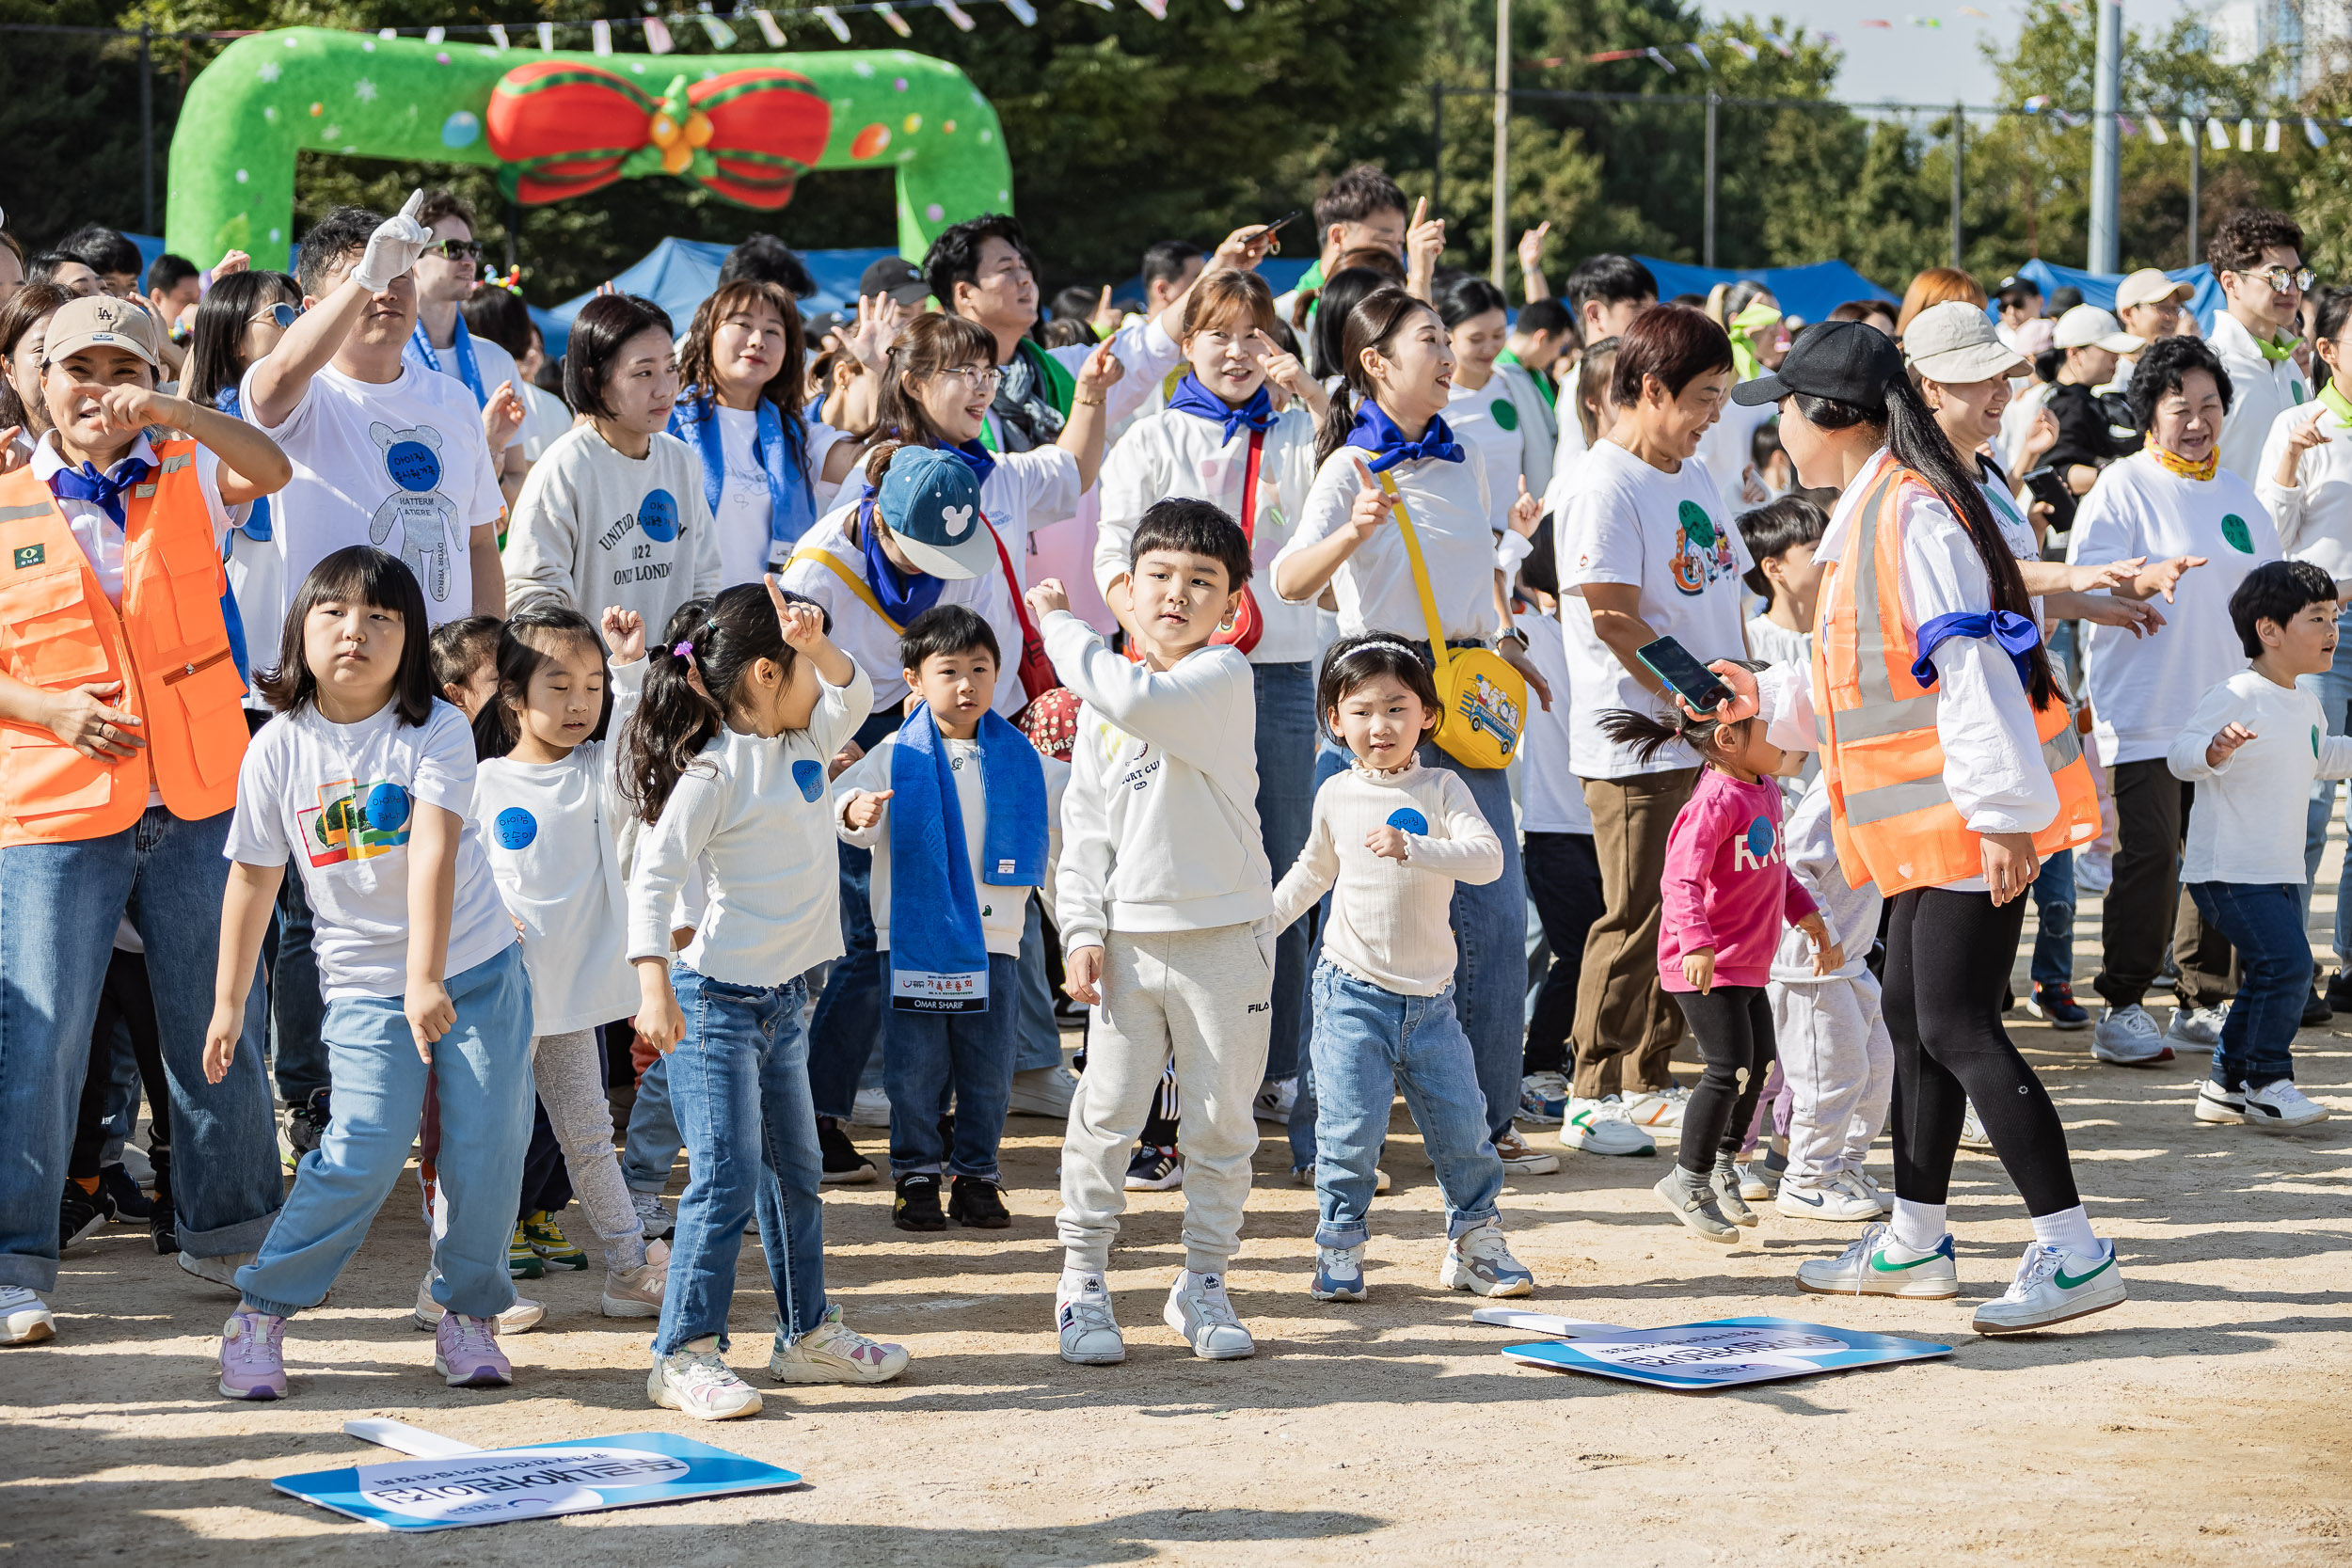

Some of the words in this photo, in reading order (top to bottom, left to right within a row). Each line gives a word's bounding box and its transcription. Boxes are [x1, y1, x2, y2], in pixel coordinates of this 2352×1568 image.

[98, 307, 112, 321] LA
[598, 513, 634, 551] UNITED
[1121, 769, 1143, 784] URT
[1392, 816, 1419, 827] 아이집
[914, 999, 937, 1009] OMAR
[938, 1001, 964, 1010] SHARIF
[1248, 1001, 1270, 1014] FILA
[642, 1277, 665, 1295] N
[368, 1457, 686, 1505] 푸르내어린이집
